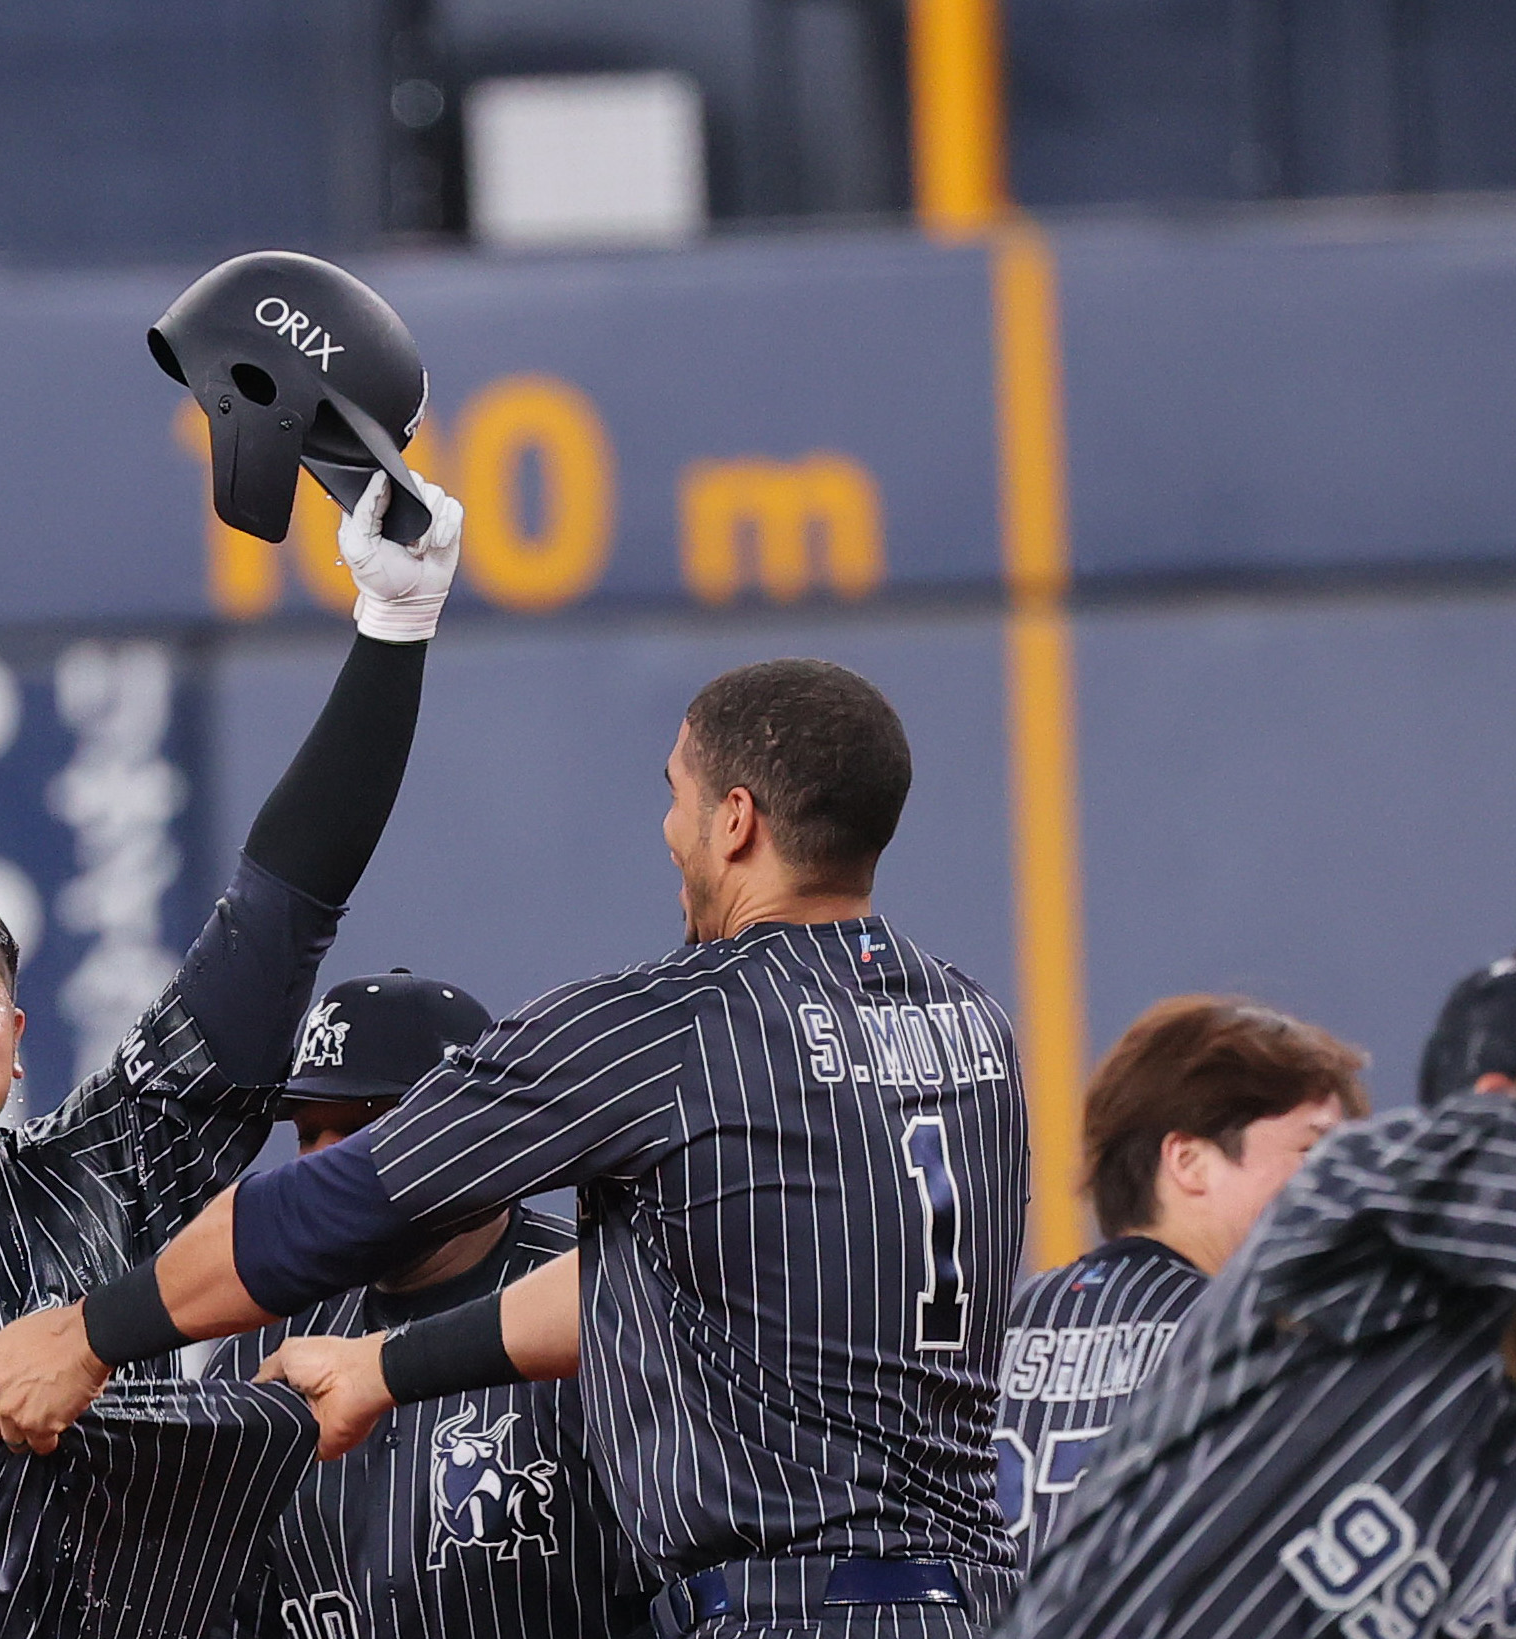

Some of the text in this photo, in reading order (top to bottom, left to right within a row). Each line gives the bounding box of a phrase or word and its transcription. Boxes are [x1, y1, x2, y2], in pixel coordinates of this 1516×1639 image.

[254, 296, 346, 374] ORIX
[676, 448, 885, 606] m
[798, 1001, 1005, 1086] S.MOYA
[901, 1116, 970, 1351] 1
